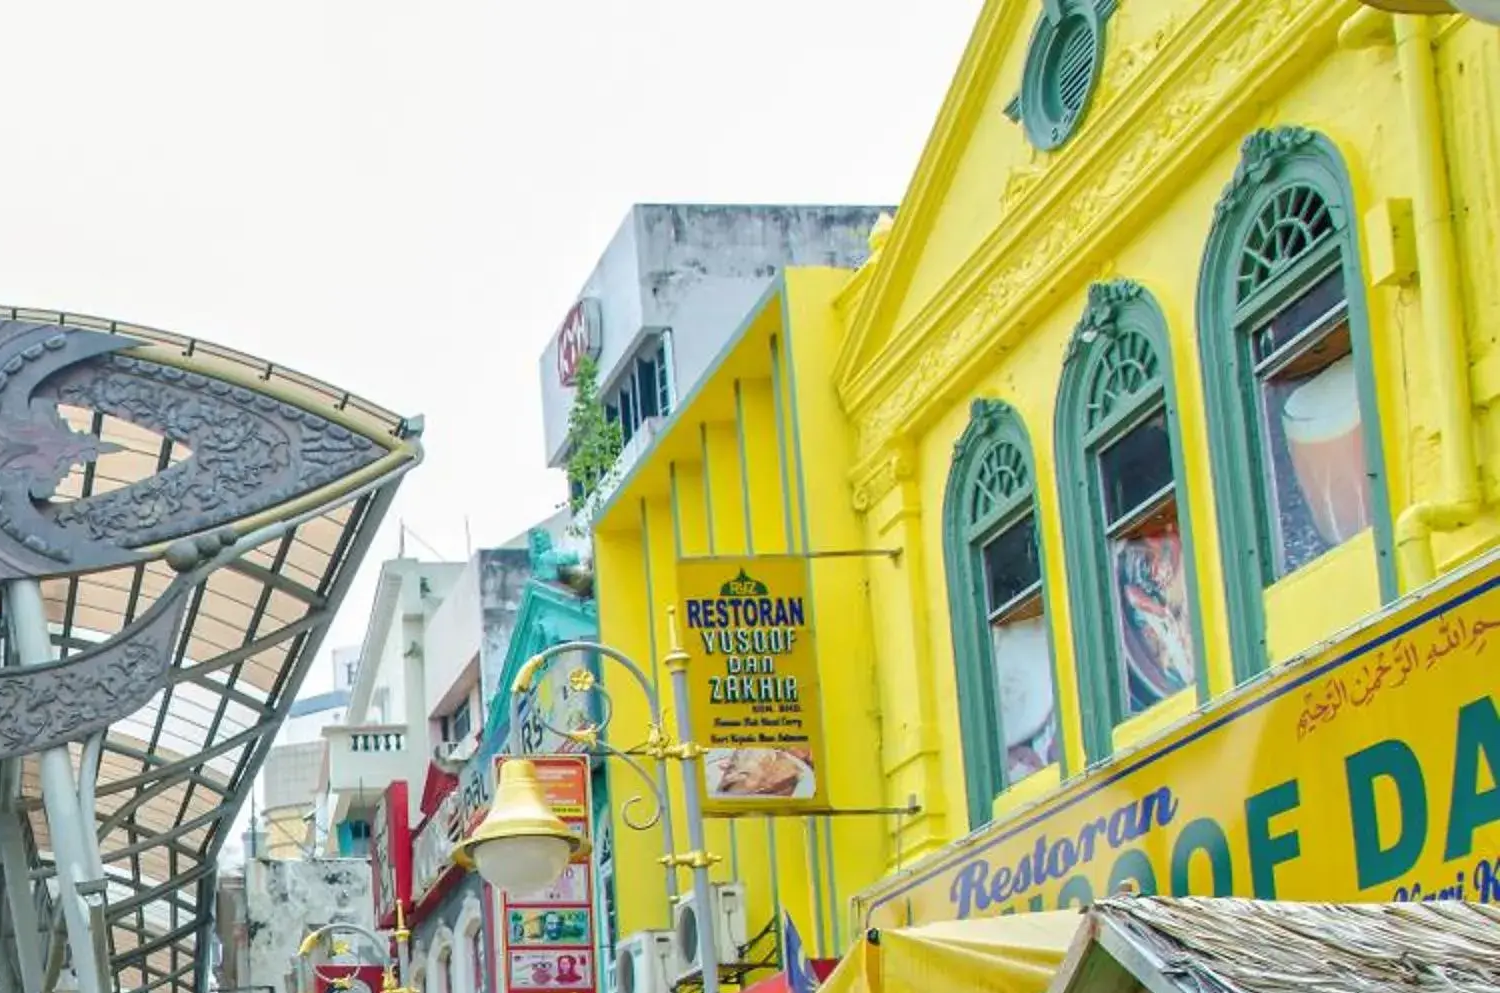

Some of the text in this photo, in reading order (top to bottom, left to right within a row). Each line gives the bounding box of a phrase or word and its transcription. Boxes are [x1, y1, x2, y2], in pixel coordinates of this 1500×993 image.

[686, 597, 805, 628] RESTORAN
[700, 627, 798, 655] YUSOOF
[950, 786, 1179, 920] Restoran
